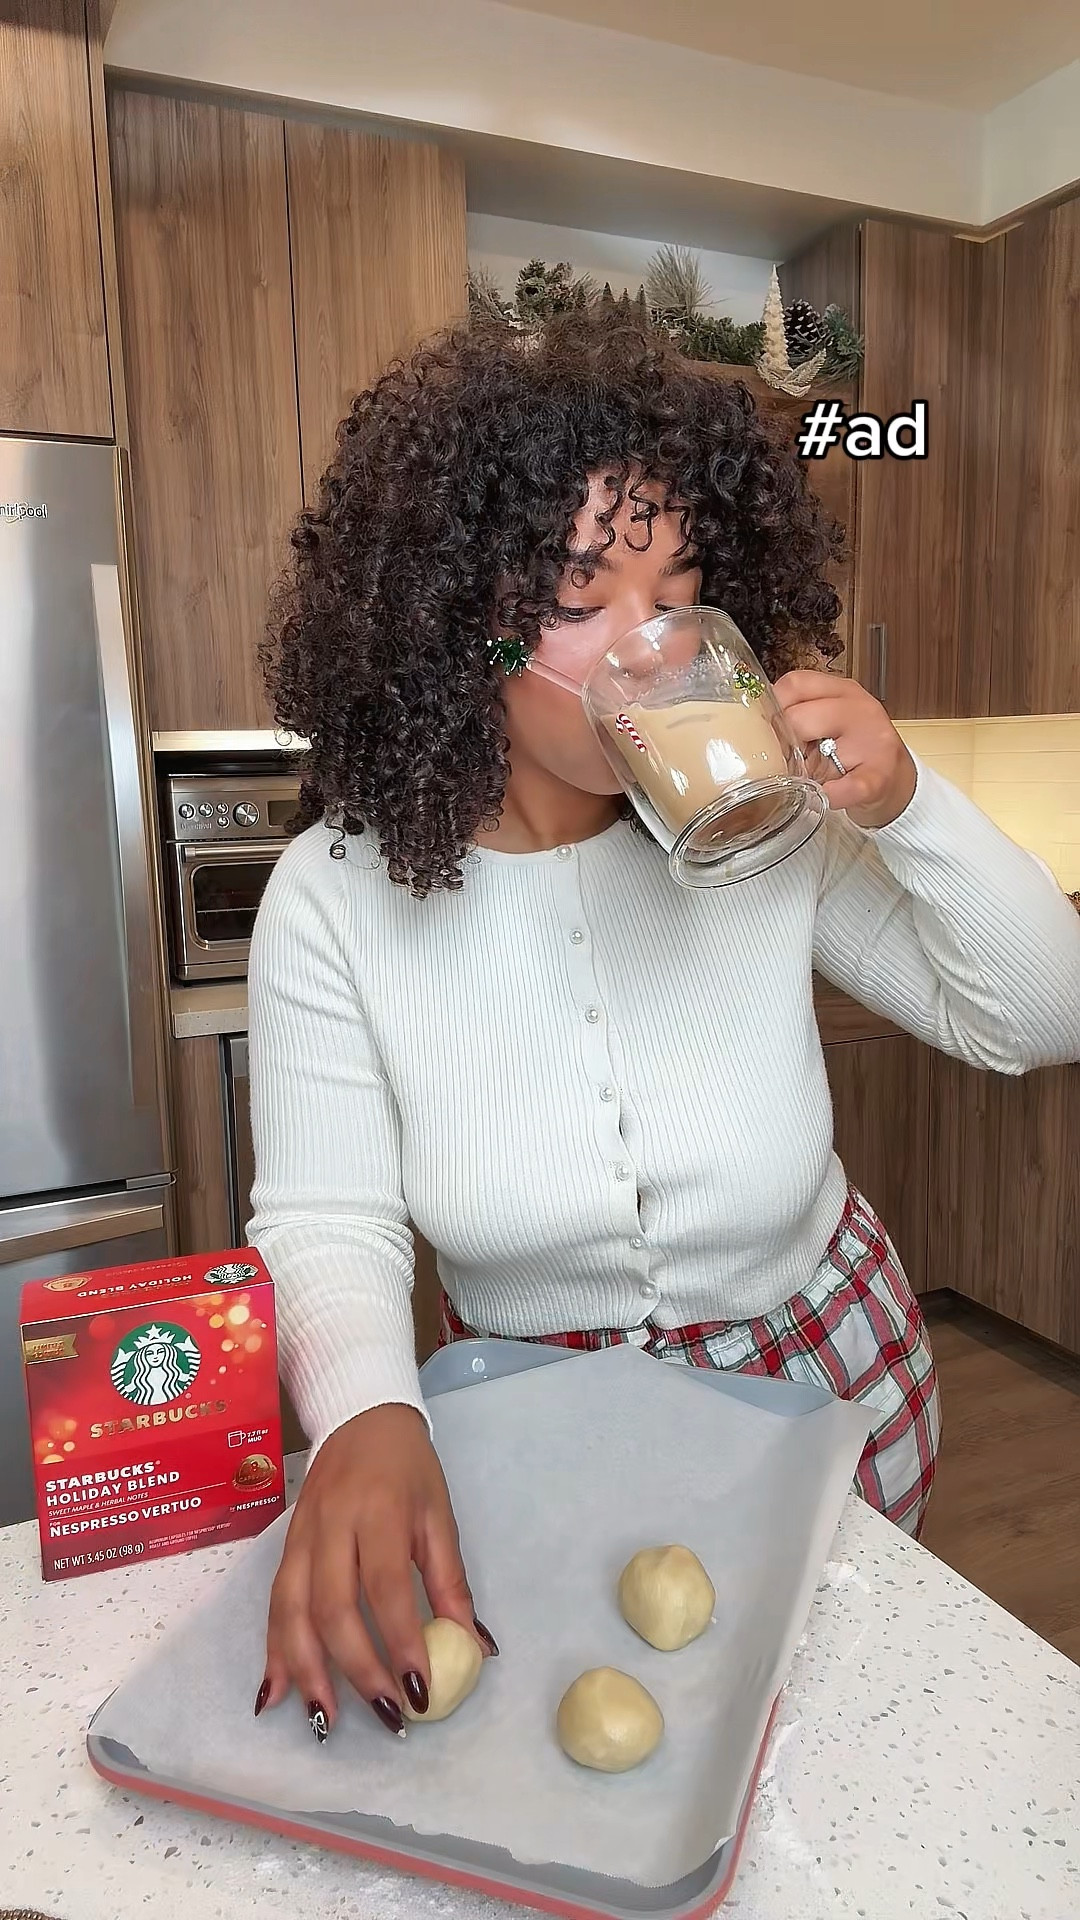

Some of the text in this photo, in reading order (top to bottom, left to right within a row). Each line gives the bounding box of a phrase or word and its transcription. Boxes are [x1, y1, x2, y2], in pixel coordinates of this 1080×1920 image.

[76, 1285, 125, 1298] BLEND
[128, 1275, 192, 1291] HOLIDAY
[89, 1399, 227, 1438] STARBUCKS
[46, 1471, 180, 1507] HOLIDAY BLEND
[48, 1507, 71, 1517] SWEET
[71, 1504, 95, 1513] MAPLE
[101, 1498, 126, 1508] HERBAL
[127, 1492, 149, 1502] NOTES
[50, 1497, 202, 1538] NESPRESSO VERTUO
[54, 1542, 145, 1571] NET WT 3.45 OZ (98 g)
